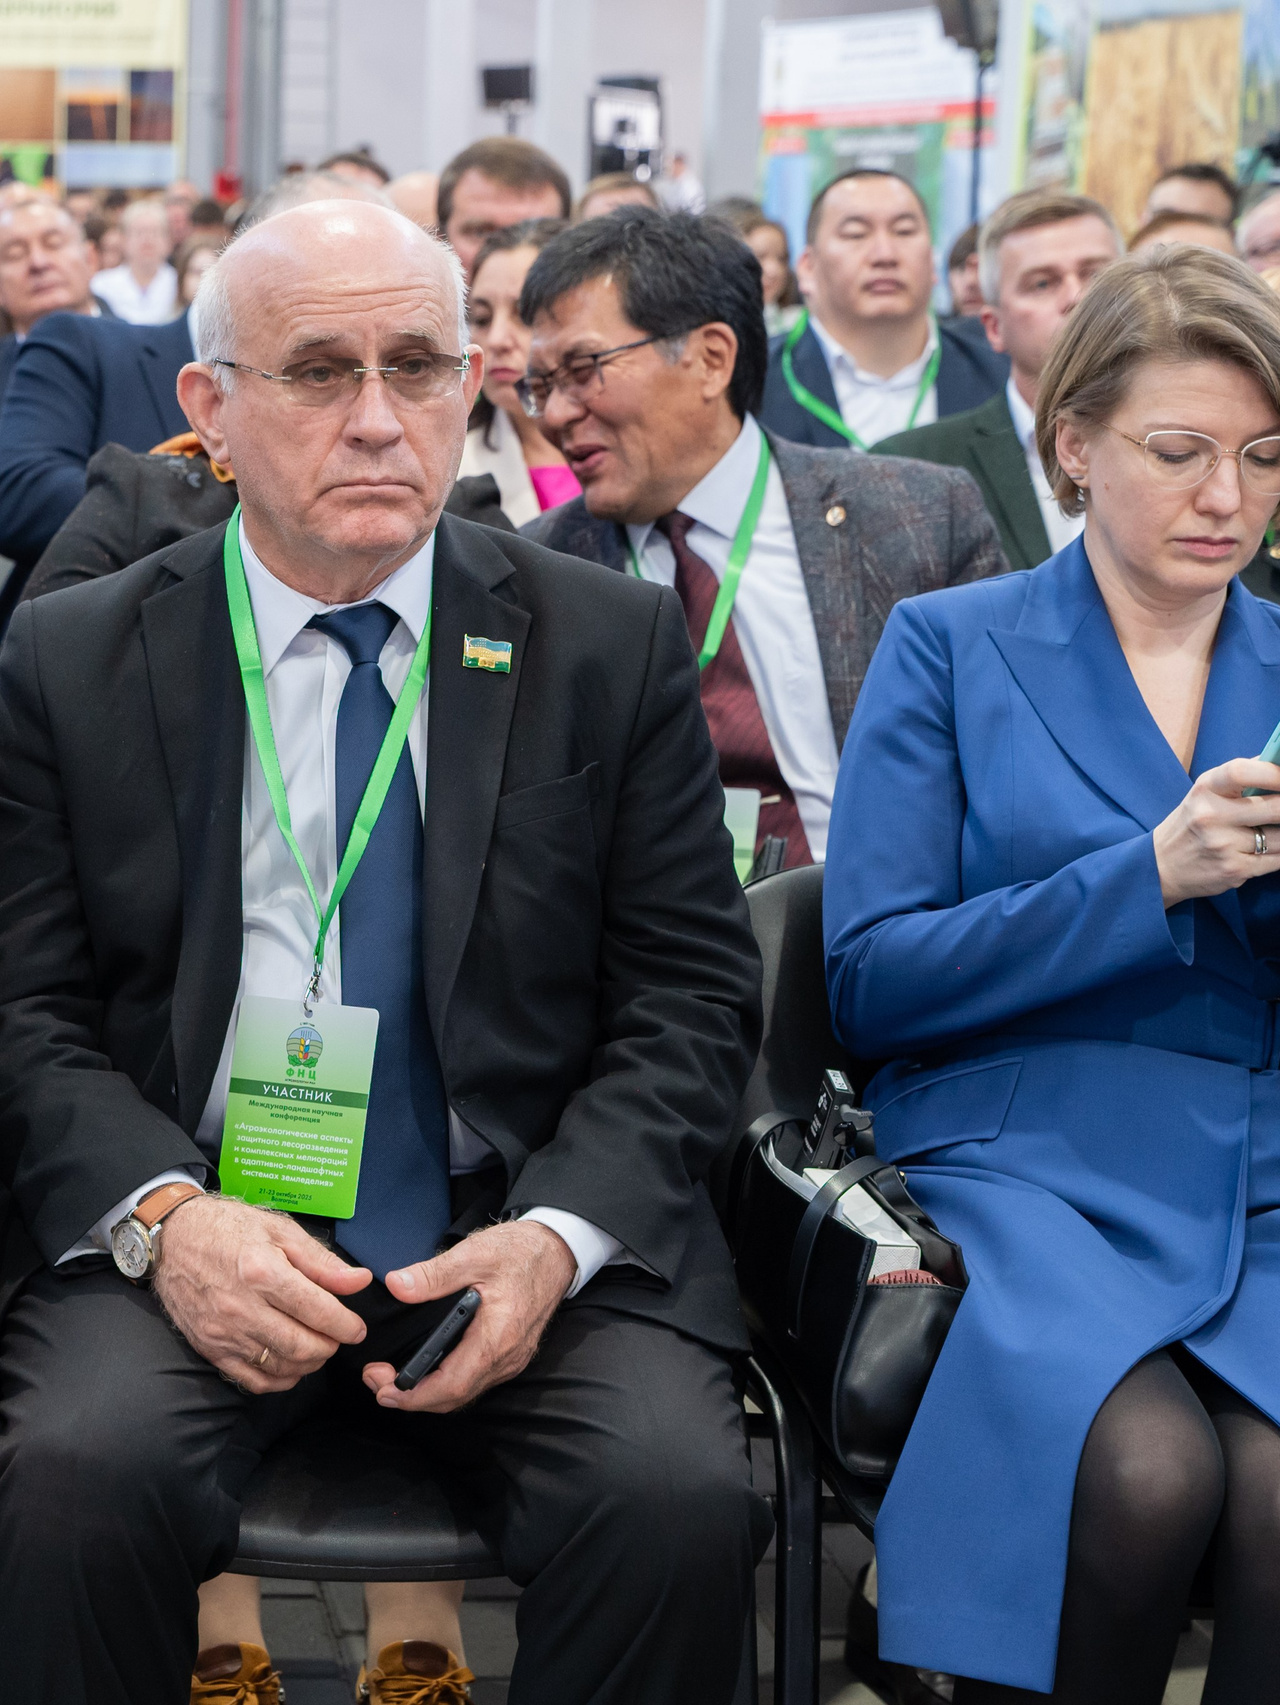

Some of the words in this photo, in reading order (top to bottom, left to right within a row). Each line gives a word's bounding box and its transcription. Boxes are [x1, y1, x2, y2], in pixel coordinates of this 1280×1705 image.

[263, 1084, 333, 1103] УЧАСТНИК
[248, 1099, 311, 1113] Международная
[311, 1109, 343, 1117] научная
[270, 1112, 321, 1123] конференция
[235, 1122, 319, 1140] «Агроэкологические
[320, 1134, 353, 1144] аспекты
[237, 1135, 280, 1146] защитного
[281, 1141, 349, 1155] лесоразведения
[241, 1147, 294, 1159] комплексных
[296, 1154, 348, 1166] мелиораций
[241, 1158, 344, 1177] адаптивно-ландшафтных
[241, 1169, 279, 1180] системах
[281, 1175, 334, 1187] земледелия»
[271, 1195, 298, 1205] Волгоград
